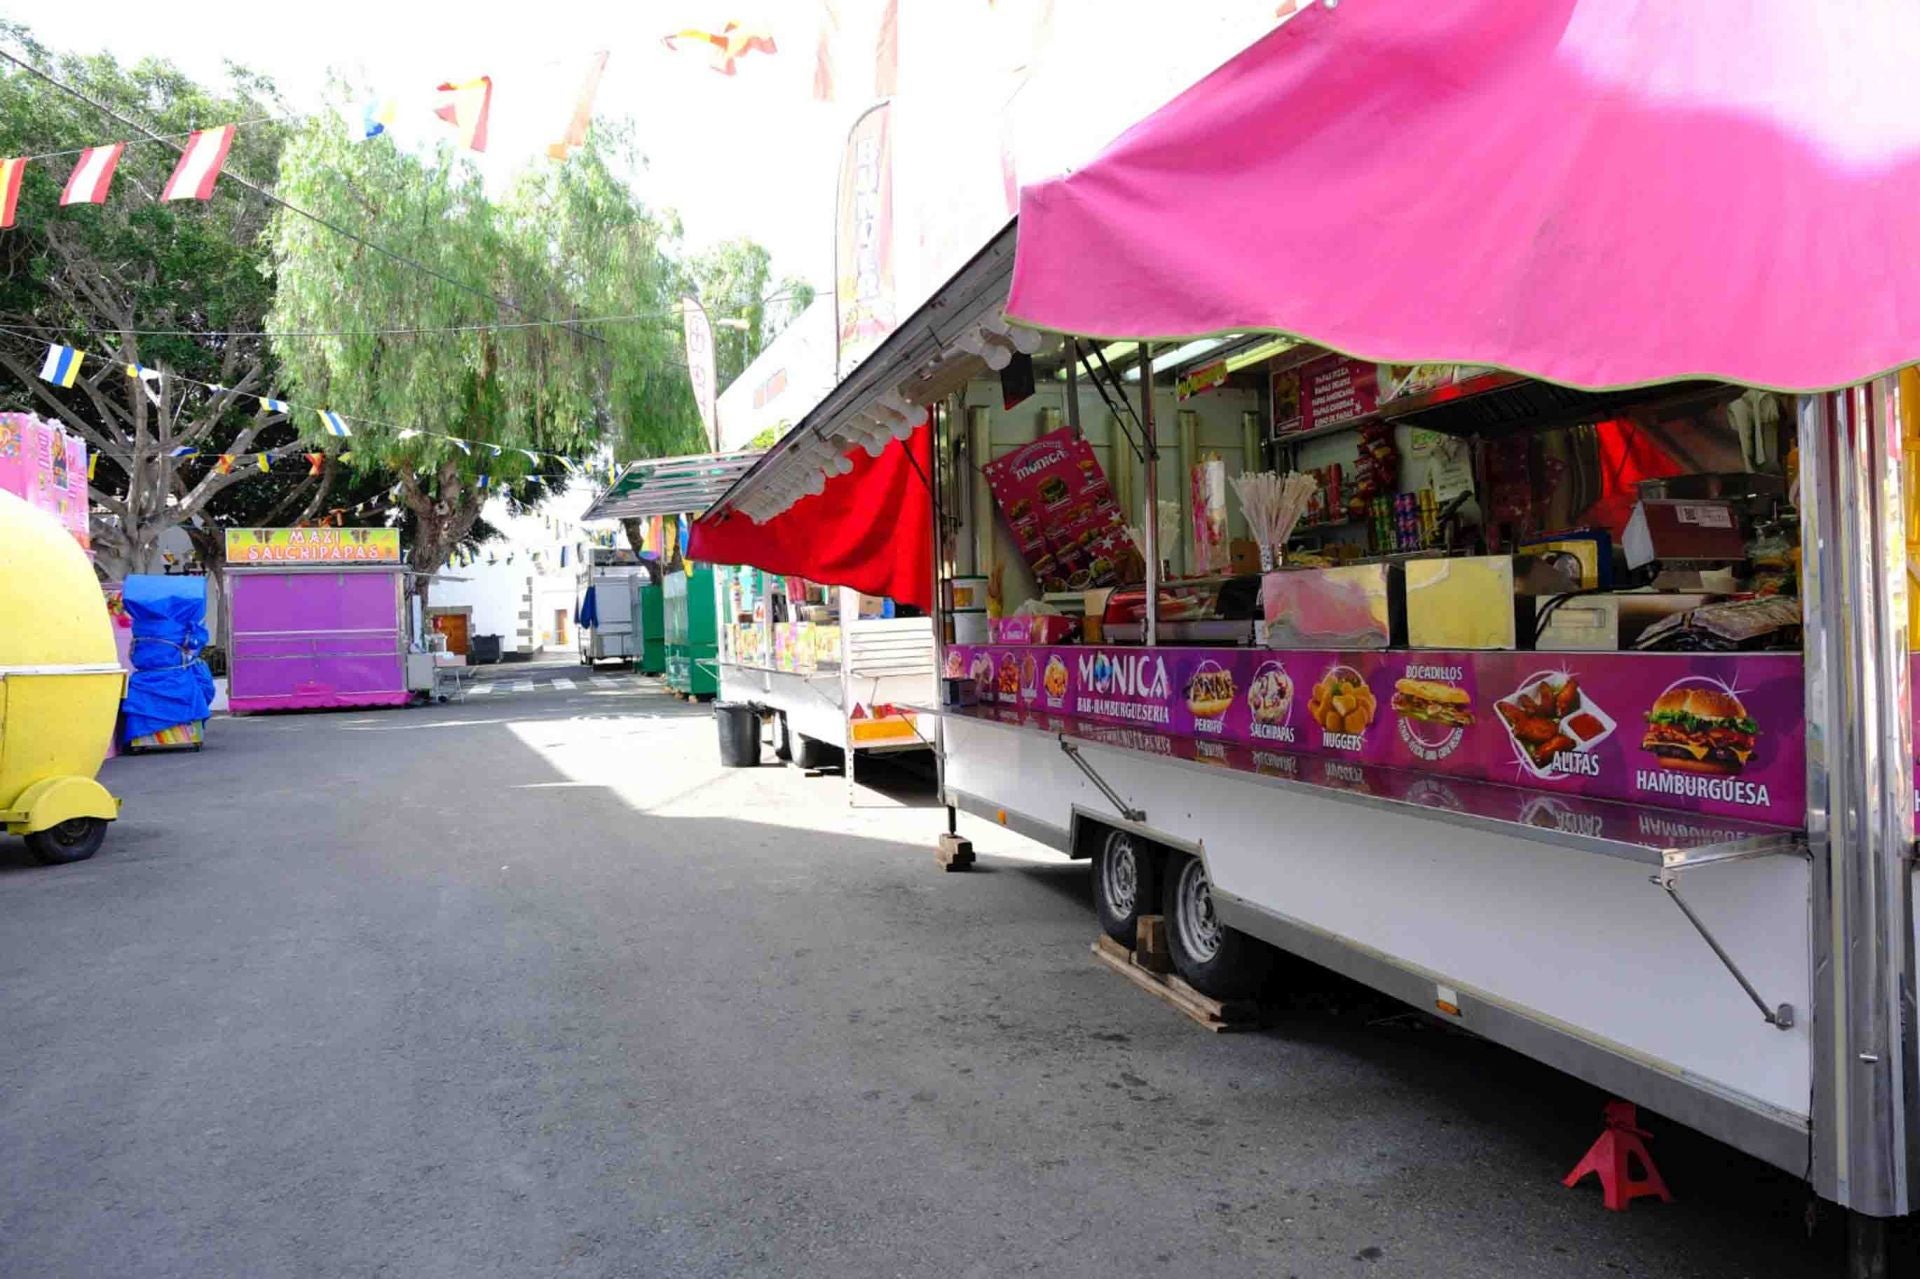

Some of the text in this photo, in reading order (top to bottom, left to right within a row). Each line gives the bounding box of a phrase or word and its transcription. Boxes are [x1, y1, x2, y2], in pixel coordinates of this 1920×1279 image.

[288, 529, 341, 544] MAXI
[247, 545, 379, 560] SALCHIPAPAS
[1405, 664, 1464, 681] BOCADILLOS
[1194, 717, 1223, 734] PERRITO
[1250, 721, 1296, 743] SALCHIPAPAS
[1322, 731, 1363, 751] NUGGETS
[1551, 750, 1600, 776] ALITAS
[1636, 769, 1771, 807] HAMBURGUESA
